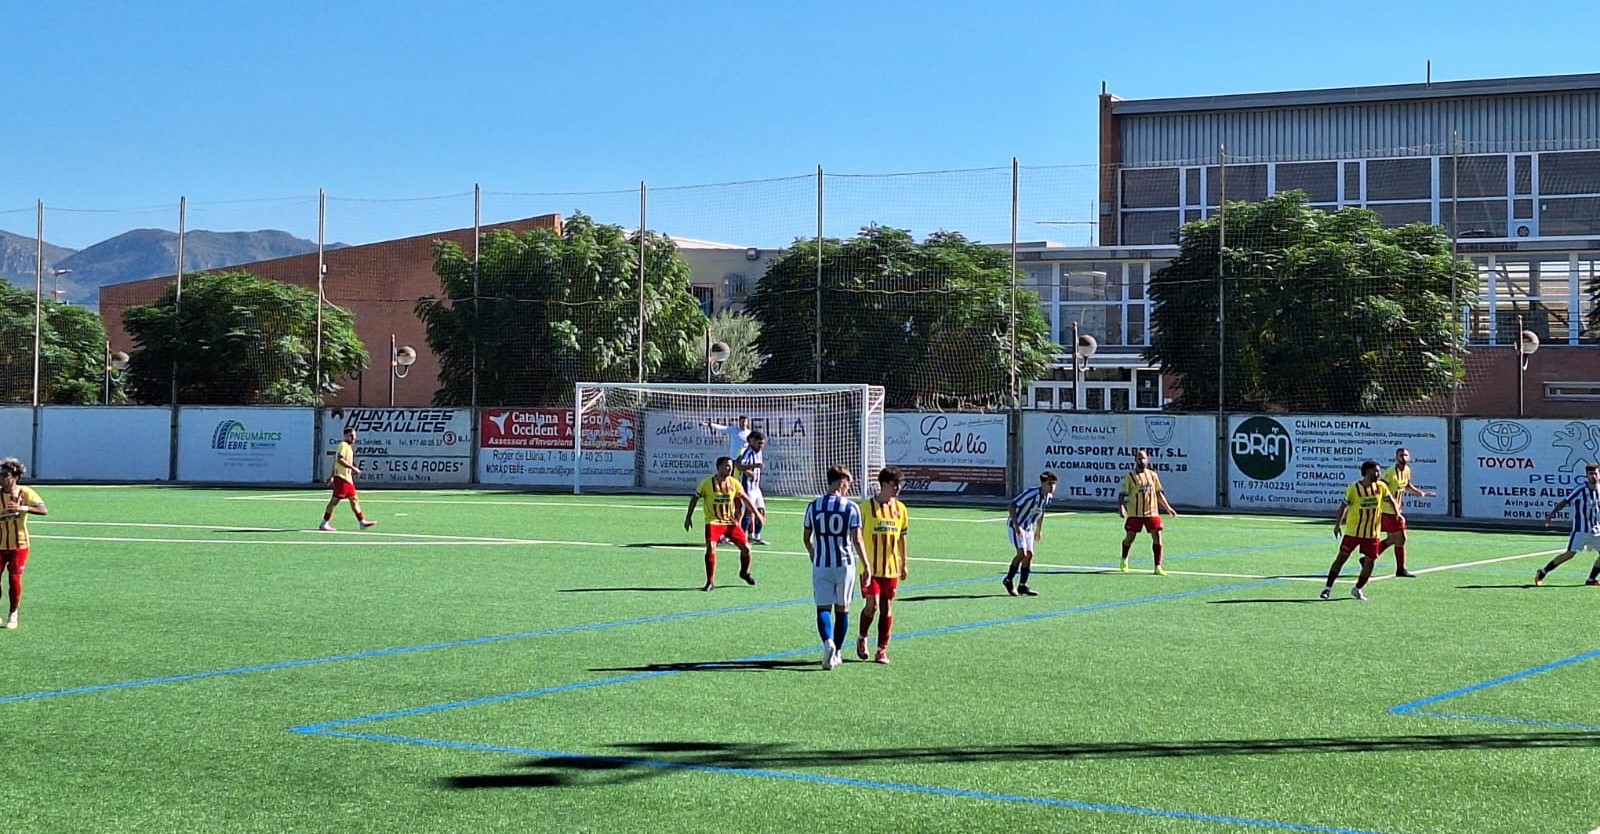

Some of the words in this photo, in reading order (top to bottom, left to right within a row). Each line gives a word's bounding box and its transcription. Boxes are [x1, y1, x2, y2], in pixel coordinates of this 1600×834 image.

[511, 411, 559, 424] Catalana
[566, 412, 611, 425] ECODA
[511, 423, 559, 437] Occident
[1071, 425, 1117, 434] RENAULT
[1295, 418, 1333, 429] CLÍNICA
[1334, 420, 1372, 430] DENTAL
[229, 431, 282, 441] PNEUMÀTICS
[227, 441, 248, 450] EBRE
[493, 450, 514, 463] Roger
[1045, 445, 1115, 458] AUTO-SPORT
[1166, 448, 1188, 459] S.L.
[411, 460, 418, 471] 4
[1045, 460, 1116, 472] AV.COMARQUES
[1477, 457, 1535, 470] TOYOTA
[1095, 488, 1116, 499] 977
[1480, 486, 1537, 498] TALLERS
[1239, 494, 1266, 504] Avgda.
[1406, 500, 1432, 509] d'Ebre
[1504, 499, 1545, 508] Avinguda
[815, 512, 845, 535] 10
